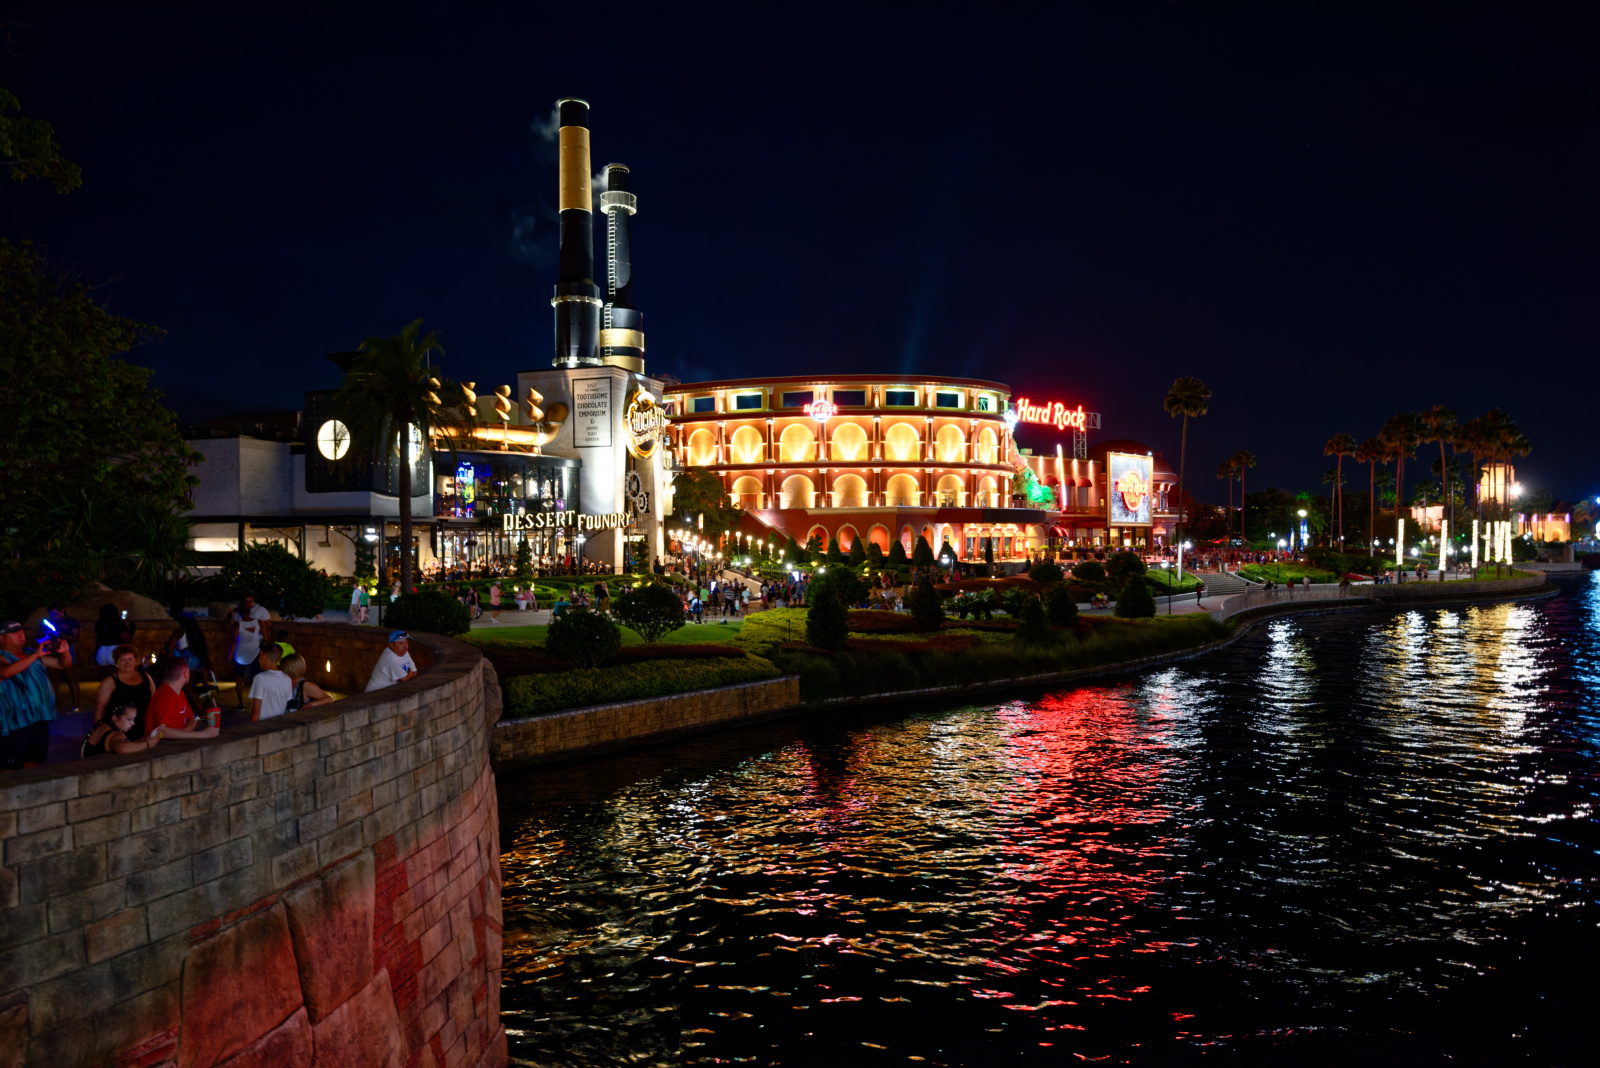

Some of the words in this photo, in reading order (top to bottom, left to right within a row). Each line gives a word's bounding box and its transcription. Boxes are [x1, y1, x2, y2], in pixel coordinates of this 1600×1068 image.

[576, 392, 609, 401] TOOTHSOME
[577, 401, 608, 410] CHOCOLATE
[578, 410, 607, 418] EMPORIUM
[1017, 397, 1053, 424] Hard
[1053, 401, 1087, 432] Rock
[1116, 480, 1134, 493] Hard
[1134, 480, 1149, 496] Rock
[503, 510, 576, 531] DESSERT
[577, 510, 632, 531] FOUNDRY
